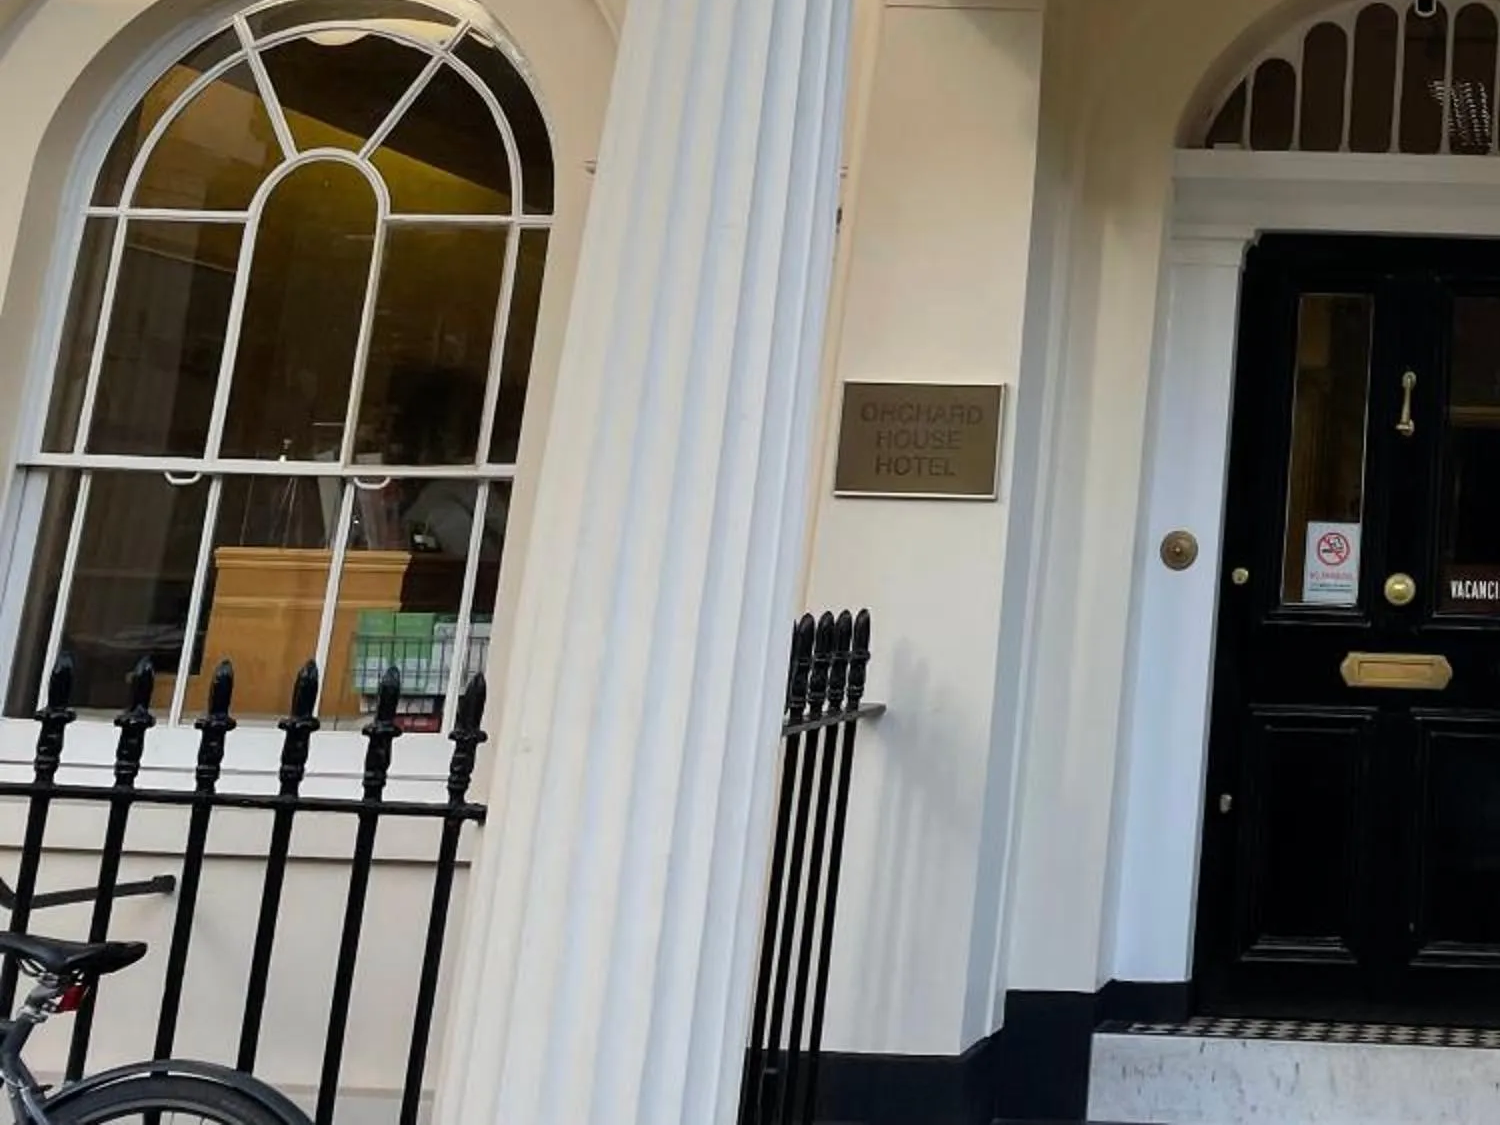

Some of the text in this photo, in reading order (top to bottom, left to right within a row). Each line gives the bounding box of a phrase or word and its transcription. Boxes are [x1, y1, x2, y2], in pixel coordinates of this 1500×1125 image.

[860, 401, 984, 425] ORCHARD
[875, 428, 963, 450] HOUSE
[874, 454, 957, 477] HOTEL
